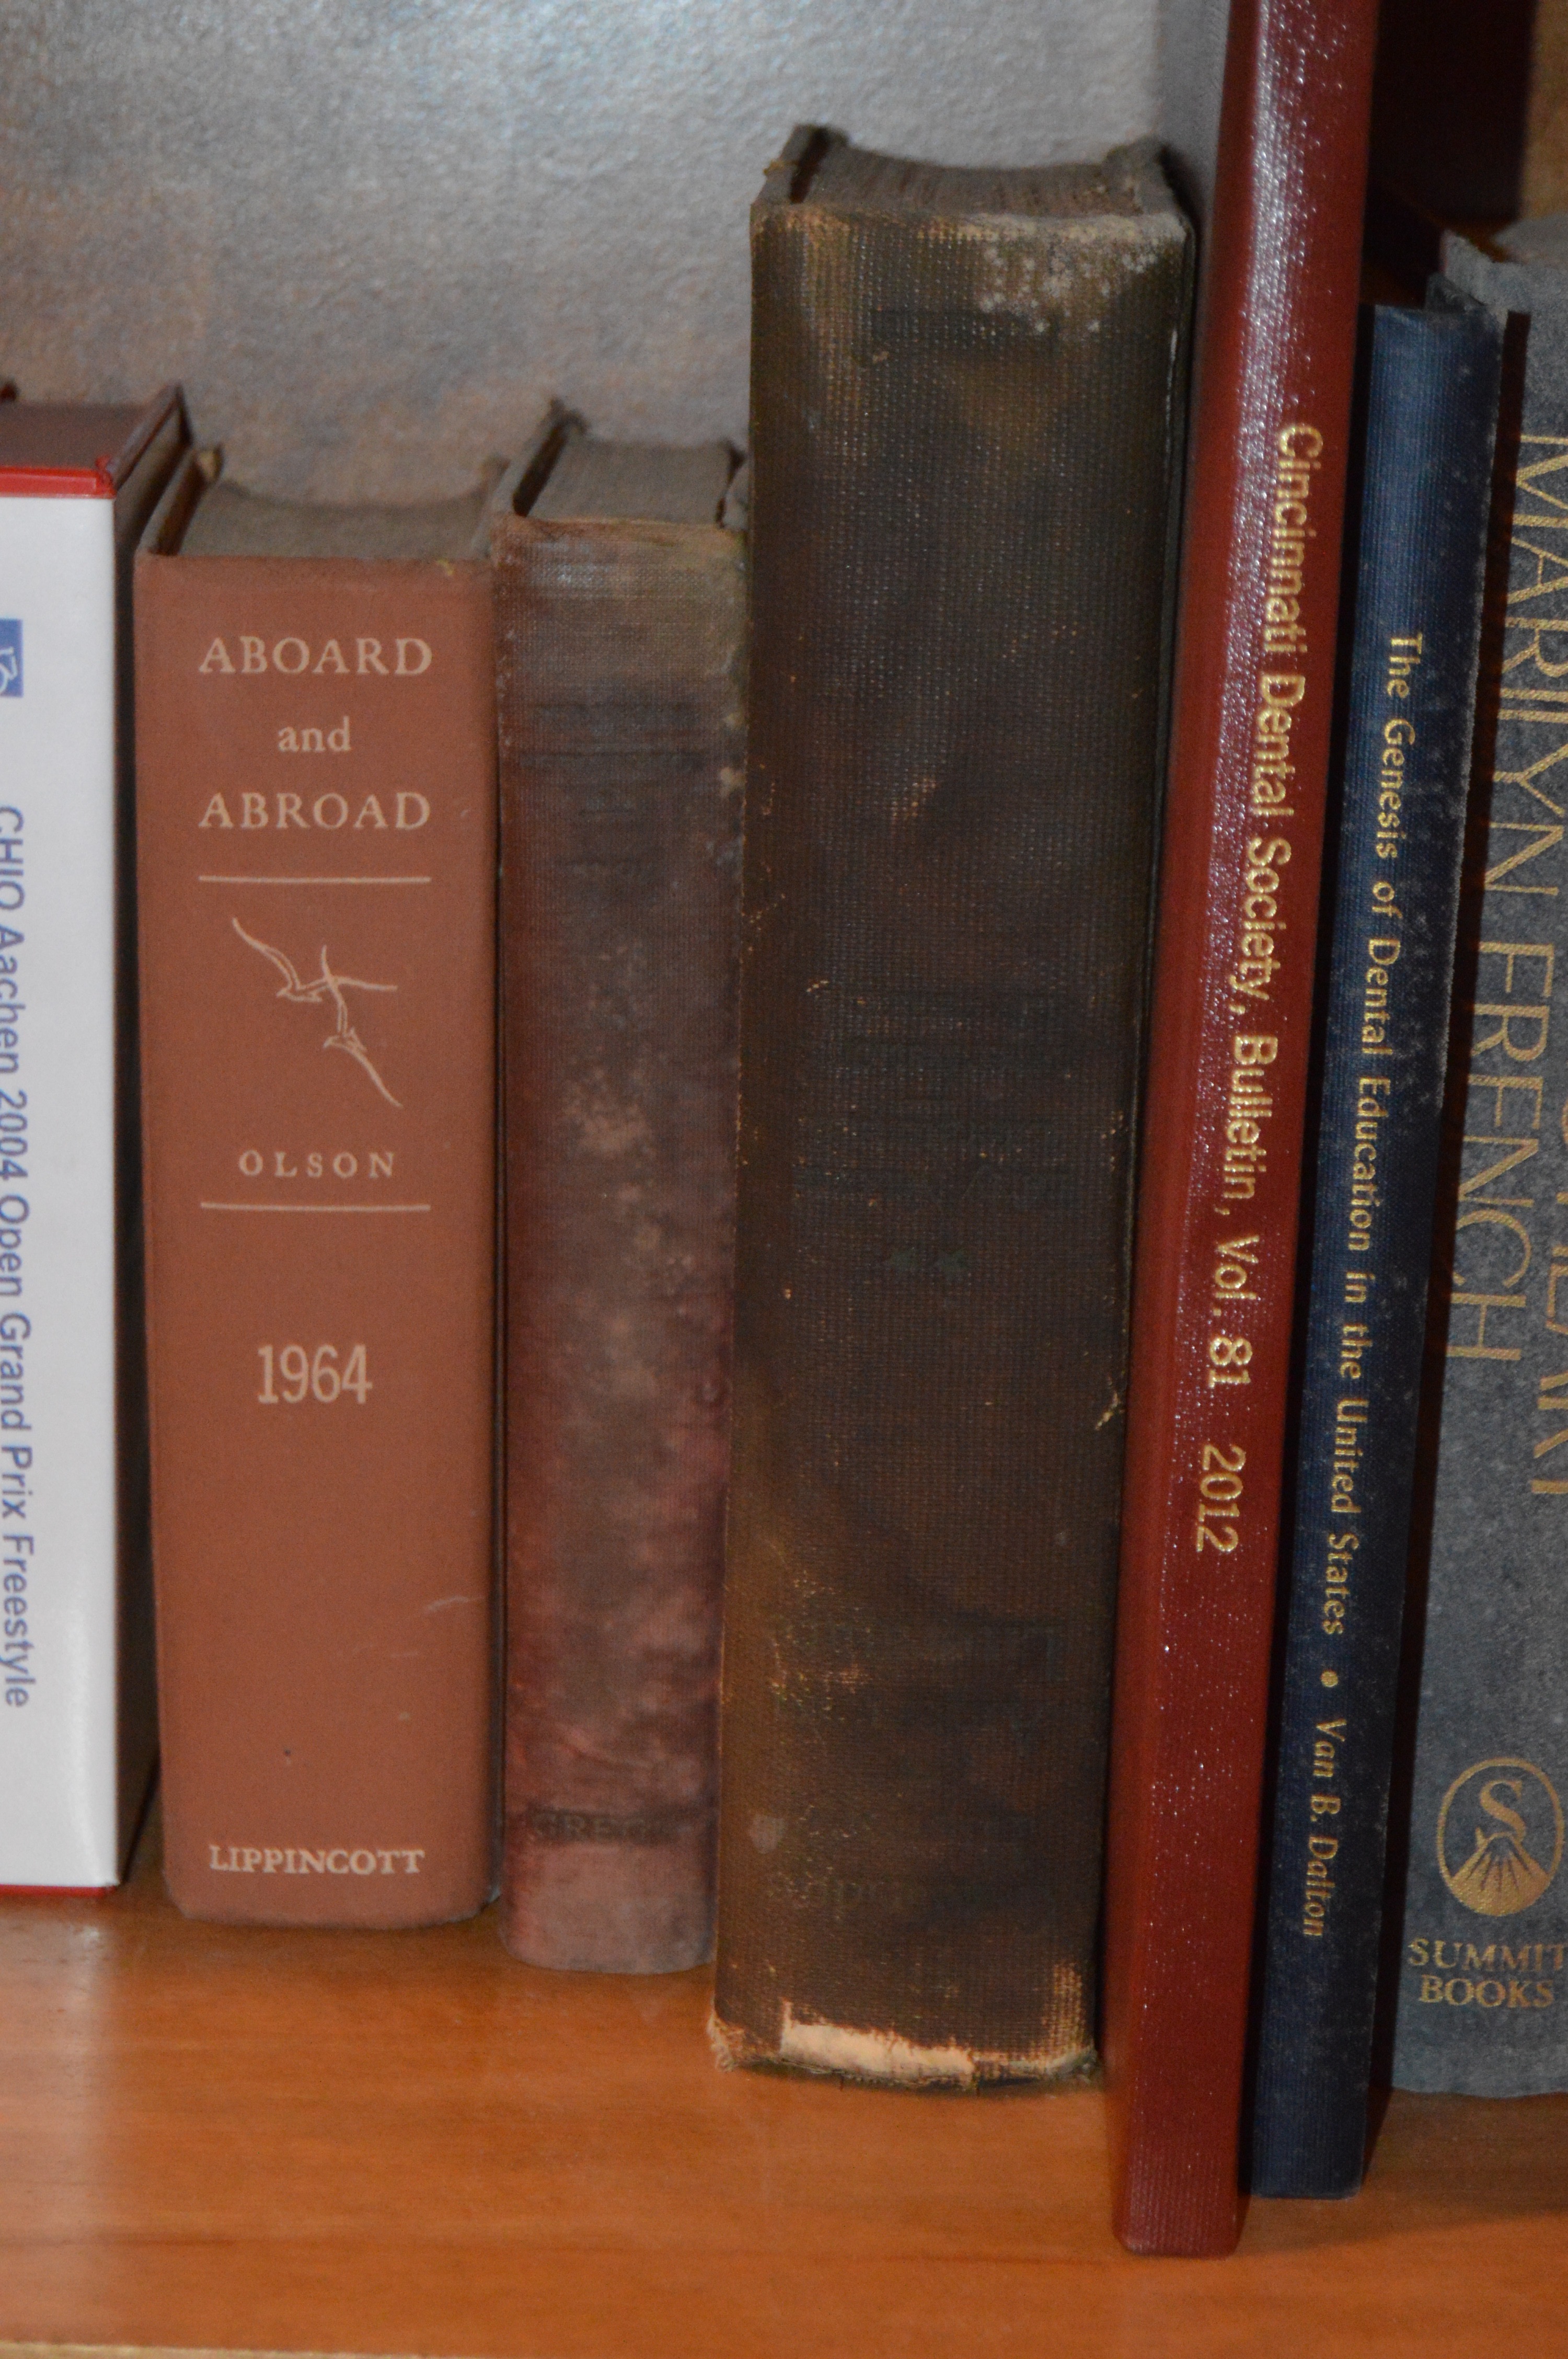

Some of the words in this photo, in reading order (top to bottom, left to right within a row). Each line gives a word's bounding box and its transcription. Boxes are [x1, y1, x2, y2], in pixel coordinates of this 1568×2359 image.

[1264, 424, 1323, 654] Cincinnati
[199, 636, 433, 675] ABOARD
[1387, 632, 1423, 700] The
[278, 716, 352, 752] and
[1254, 673, 1306, 817] Dental
[199, 792, 431, 830] ABROAD
[1375, 718, 1416, 860] Genesis
[0, 806, 26, 911] CHIO
[1371, 880, 1403, 919] of
[1229, 837, 1292, 1015] Society,
[0, 924, 27, 1074] Aachen
[1362, 937, 1402, 1056] Dental
[0, 1089, 29, 1182] 2004
[239, 1149, 395, 1178] OLSON
[1216, 1034, 1278, 1215] Bulletin,
[1347, 1076, 1391, 1252] Education
[1445, 940, 1554, 1360] FRENCH
[0, 1194, 30, 1297] Open
[1213, 1234, 1260, 1316] Vol.
[1344, 1271, 1376, 1304] in
[0, 1313, 32, 1431] Grand
[257, 1344, 373, 1405] 1964
[1208, 1336, 1253, 1388] 81
[1340, 1323, 1373, 1380] the
[1, 1446, 33, 1520] Prix
[1196, 1444, 1247, 1553] 2012
[1330, 1398, 1369, 1514] United
[0, 1533, 37, 1709] Freestyle
[1322, 1532, 1359, 1635] States
[1312, 1718, 1347, 1779] Van
[1310, 1794, 1341, 1823] B.
[209, 1844, 425, 1875] LIPPINCOTT
[1304, 1836, 1339, 1938] Dalton
[1408, 1937, 1568, 1973] SUMMIT
[1419, 1974, 1555, 2009] BOOKS
